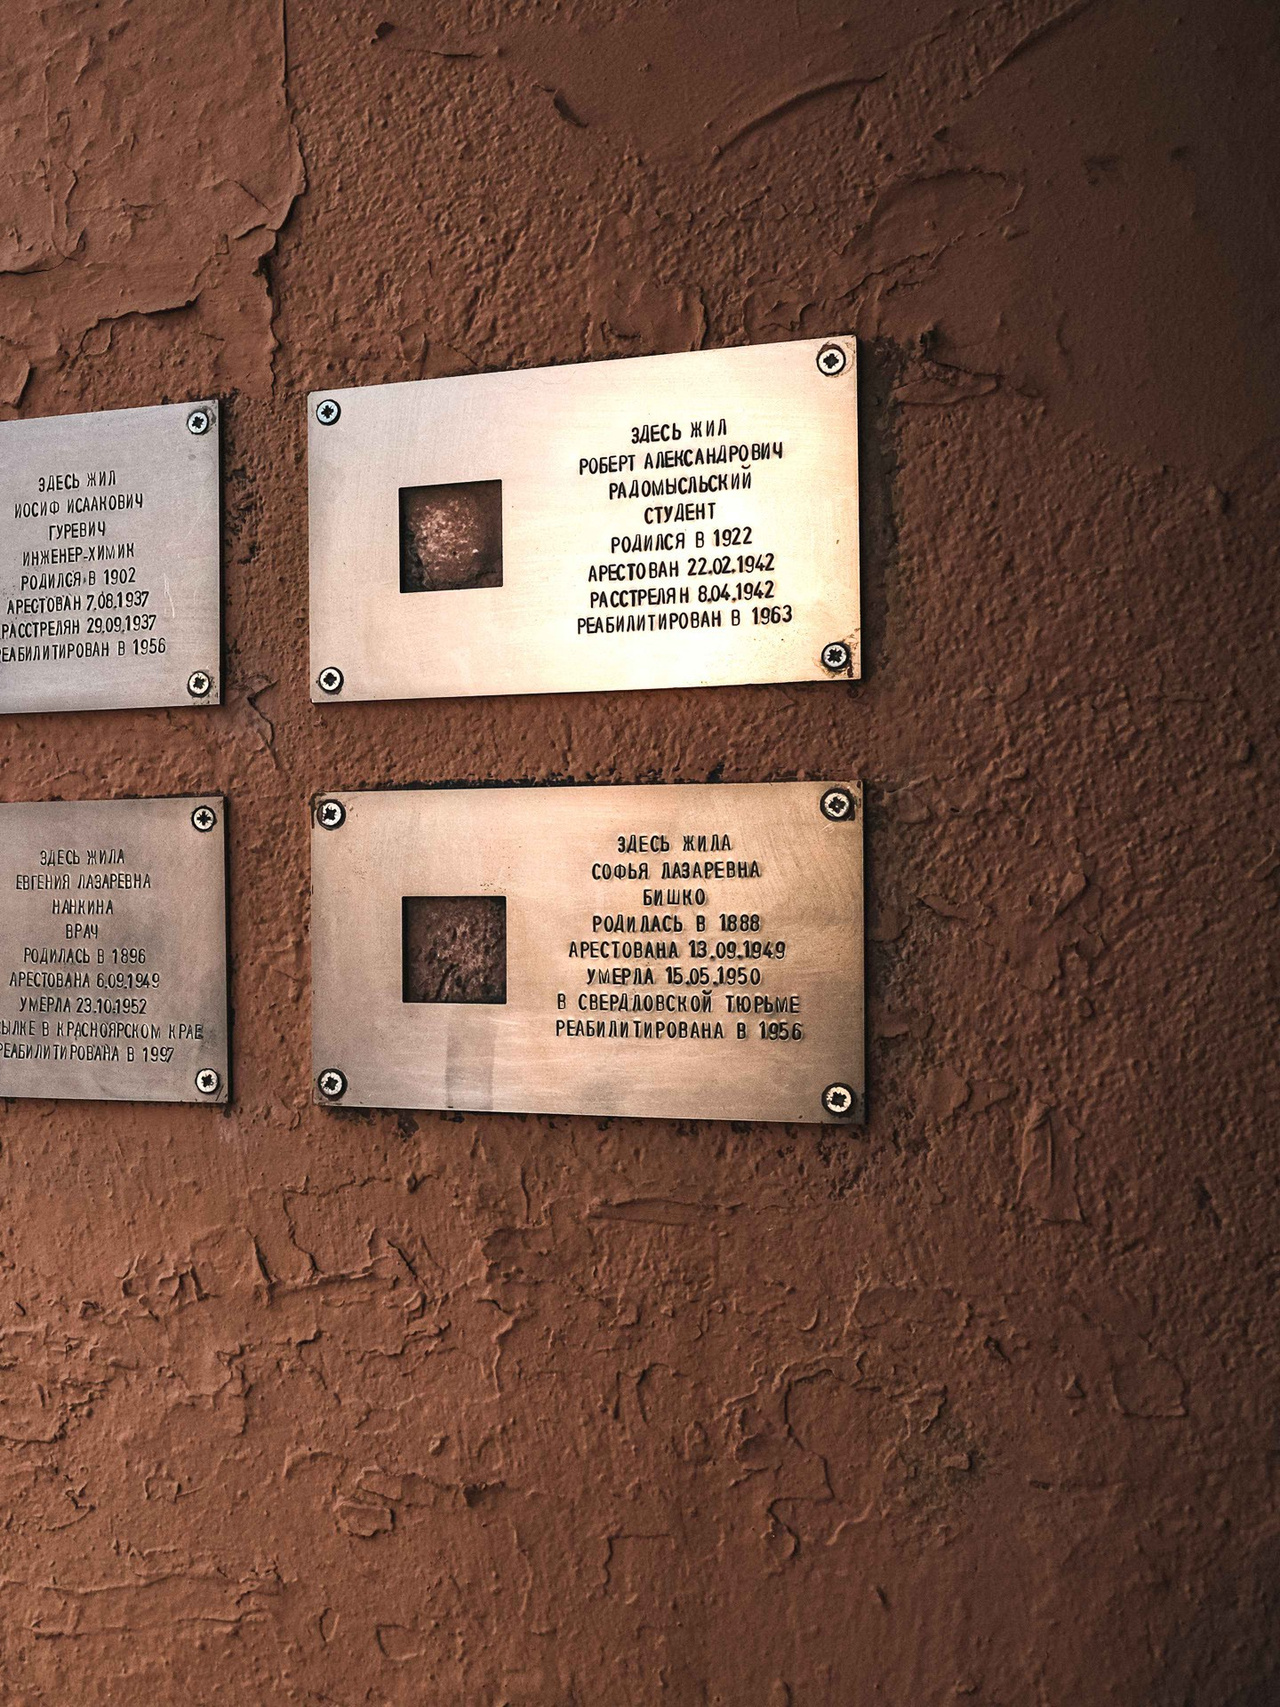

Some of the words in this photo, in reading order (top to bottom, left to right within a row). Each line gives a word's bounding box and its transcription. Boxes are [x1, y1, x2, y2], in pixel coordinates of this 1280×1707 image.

[631, 422, 682, 445] ЗДЕСЬ
[690, 418, 727, 438] ЖИЛ
[579, 454, 636, 476] РОБЕРТ
[644, 441, 783, 470] АЛЕКСАНДРОВИЧ
[38, 473, 80, 493] ЗДЕСЬ
[86, 470, 116, 487] ЖИЛ
[609, 464, 752, 500] РАДОМЫСЛЬСКИЙ
[14, 500, 60, 519] ИОСИФ
[67, 493, 144, 513] ИСААКОВИЧ
[644, 502, 716, 524] СТУДЕНТ
[49, 521, 106, 540] ГУРЕВИЧ
[611, 532, 685, 554] РОДИЛСЯ
[695, 531, 704, 549] В
[713, 526, 753, 547] 1922
[22, 543, 135, 566] ИНЖЕНЕР-ХИМИК
[588, 560, 679, 583] АРЕСТОВАН
[687, 553, 775, 576] 22.02.1942
[21, 571, 81, 591] РОДИЛСЯ
[88, 570, 96, 586] В
[103, 567, 136, 585] 1902
[590, 587, 689, 609] РАССТРЕЛЯН
[697, 580, 775, 604] 8.04.1942
[7, 595, 81, 615] АРЕСТОВАН
[1, 619, 80, 639] РАССТРЕЛЯН
[86, 614, 157, 635] 29.09.1937
[577, 610, 721, 635] РЕАБИЛИТИРОВАН
[731, 609, 740, 626] В
[751, 604, 793, 625] 1963
[118, 640, 125, 656] В
[132, 638, 166, 655] 1956
[617, 834, 670, 853] ЗДЕСЬ
[683, 834, 732, 852] ЖИЛА
[40, 849, 80, 867] ЗДЕСЬ
[87, 849, 125, 865] ЖИЛА
[591, 862, 648, 880] СОФЬЯ
[661, 860, 761, 880] ЛАЗАРЕВНА
[16, 874, 70, 890] ЕВГЕНИЯ
[77, 873, 151, 890] ЛАЗАРЕВНА
[52, 899, 114, 915] НАНКИНА
[643, 888, 706, 906] БИШКО
[65, 923, 99, 939] ВРАЧ
[592, 914, 683, 933] РОДИЛАСЬ
[696, 915, 706, 932] В
[719, 914, 760, 932] 1888
[23, 947, 90, 965] РОДИЛАСЬ
[97, 948, 105, 964] В
[112, 948, 146, 964] 1896
[568, 940, 679, 959] АРЕСТОВАНА
[688, 940, 786, 960] 13.09.1949
[9, 972, 90, 988] АРЕСТОВАНА
[96, 972, 160, 989] 6.09.1949
[586, 967, 654, 985] УМЕРЛА
[665, 966, 761, 986] 15.05.1950
[19, 997, 71, 1014] УМЕРЛА
[76, 998, 147, 1015] 23.10.1952
[557, 993, 566, 1010] В
[578, 989, 712, 1013] СВЕРДЛОВСКОЙ
[725, 994, 800, 1013] ТЮРЬМЕ
[42, 1022, 49, 1037] В
[56, 1021, 161, 1039] КРАСНОЯРСКОМ
[168, 1024, 204, 1040] КРАЕ
[556, 1019, 724, 1039] РЕАБИЛИТИРОВАНА
[736, 1022, 746, 1040] В
[758, 1021, 804, 1040] 1956
[127, 1046, 135, 1062] В
[142, 1047, 174, 1063] 1997
